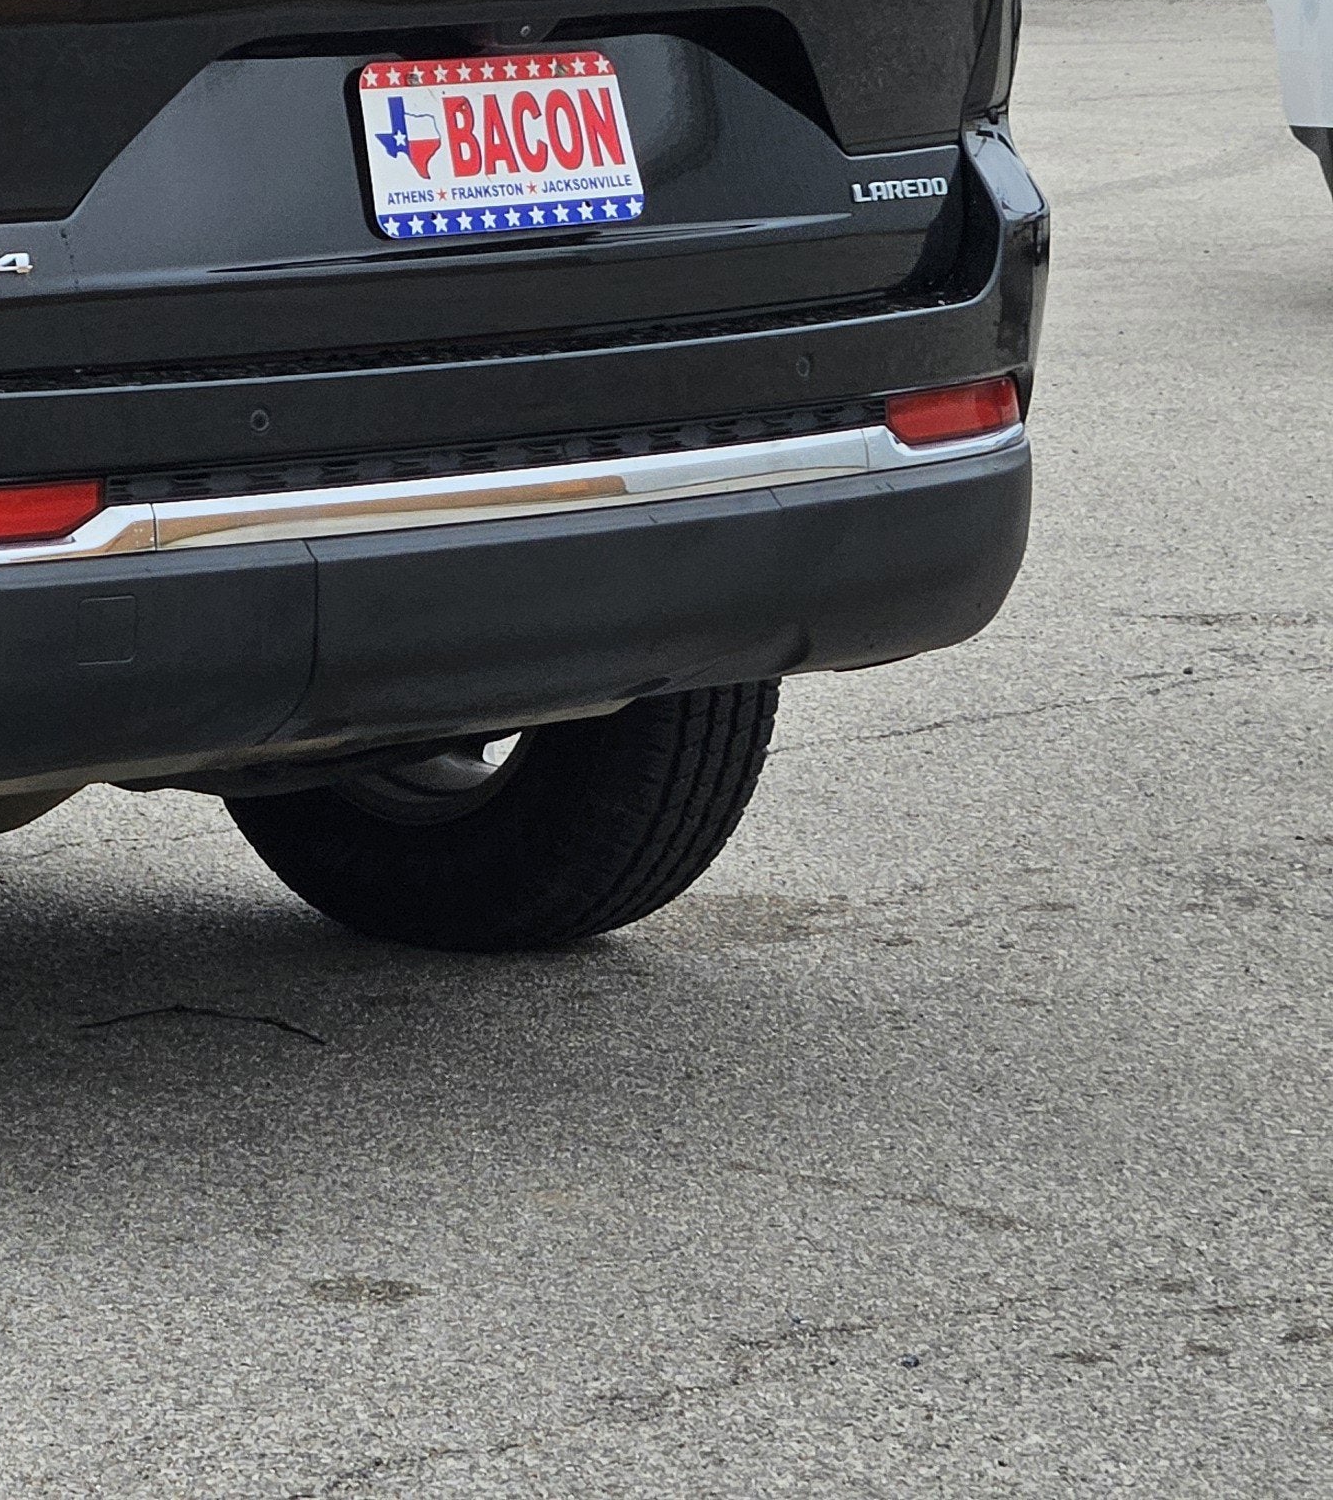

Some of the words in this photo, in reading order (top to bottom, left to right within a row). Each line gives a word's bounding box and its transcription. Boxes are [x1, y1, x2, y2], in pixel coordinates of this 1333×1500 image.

[442, 88, 626, 178] BACON
[387, 189, 435, 205] ATHENS
[451, 184, 524, 202] FRANKSTON
[541, 175, 632, 194] JACKSONVILLE
[851, 177, 949, 203] LAREDO
